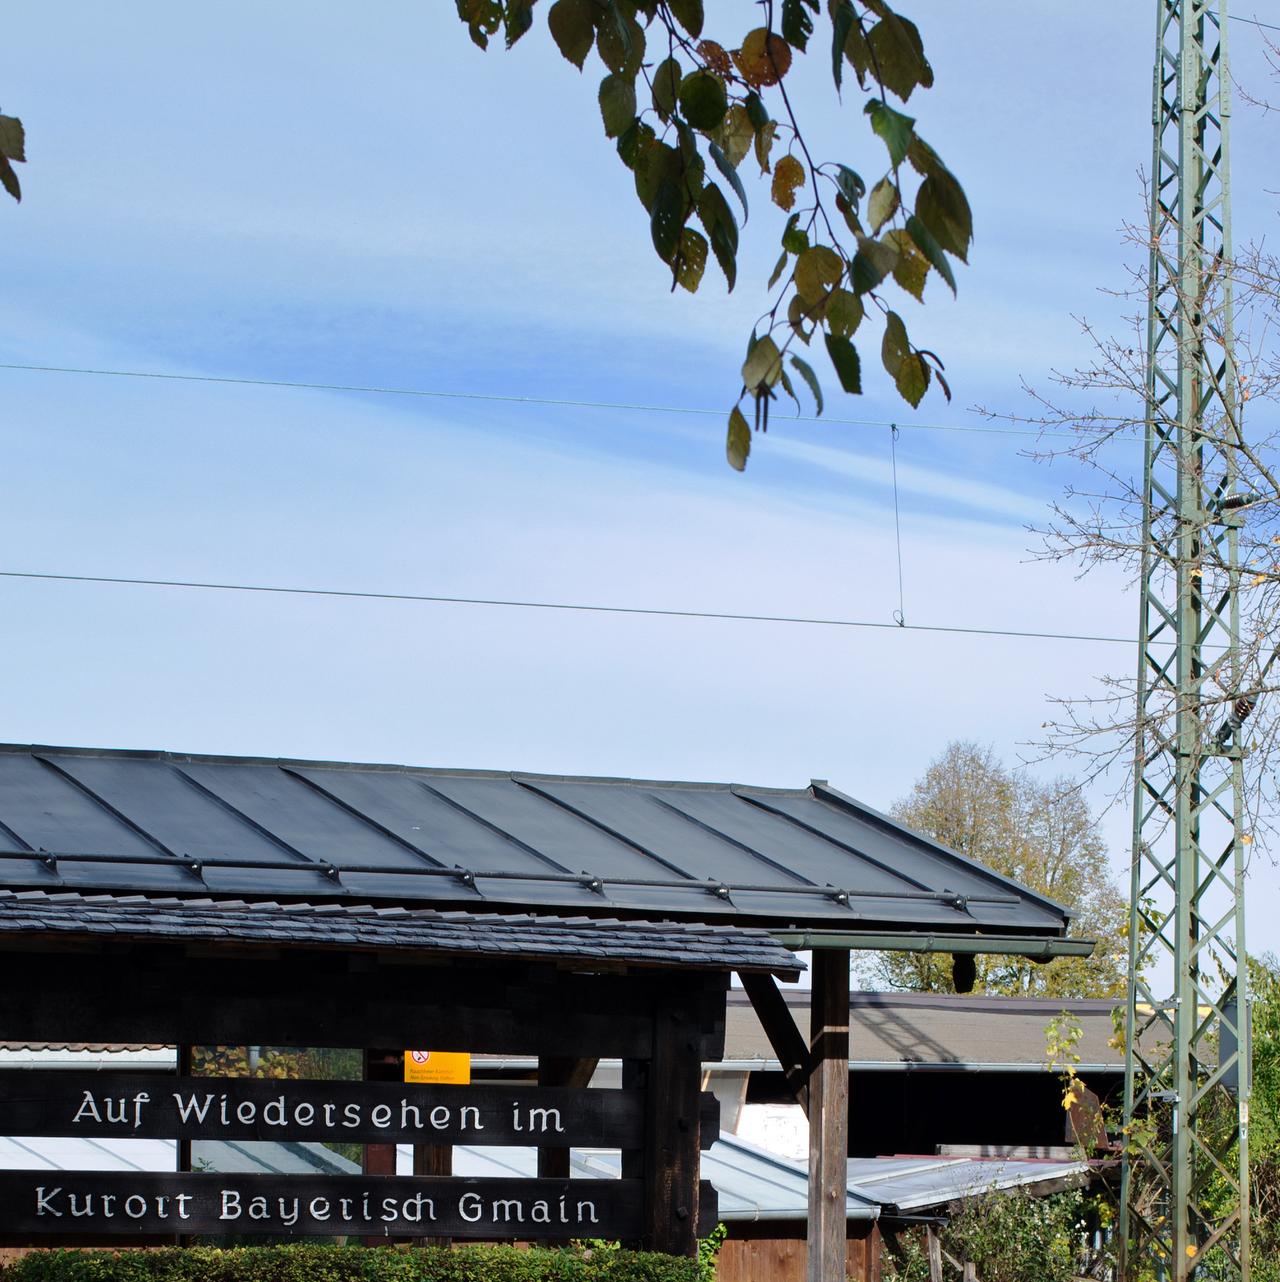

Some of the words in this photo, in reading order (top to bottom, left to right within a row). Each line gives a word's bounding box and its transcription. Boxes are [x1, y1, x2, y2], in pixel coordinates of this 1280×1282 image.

[72, 1090, 151, 1129] Auf
[173, 1093, 485, 1132] Wiedersehen
[513, 1101, 565, 1133] im
[36, 1186, 193, 1220] Kurort
[219, 1189, 438, 1228] Bayerisch
[458, 1192, 602, 1225] Gmain
